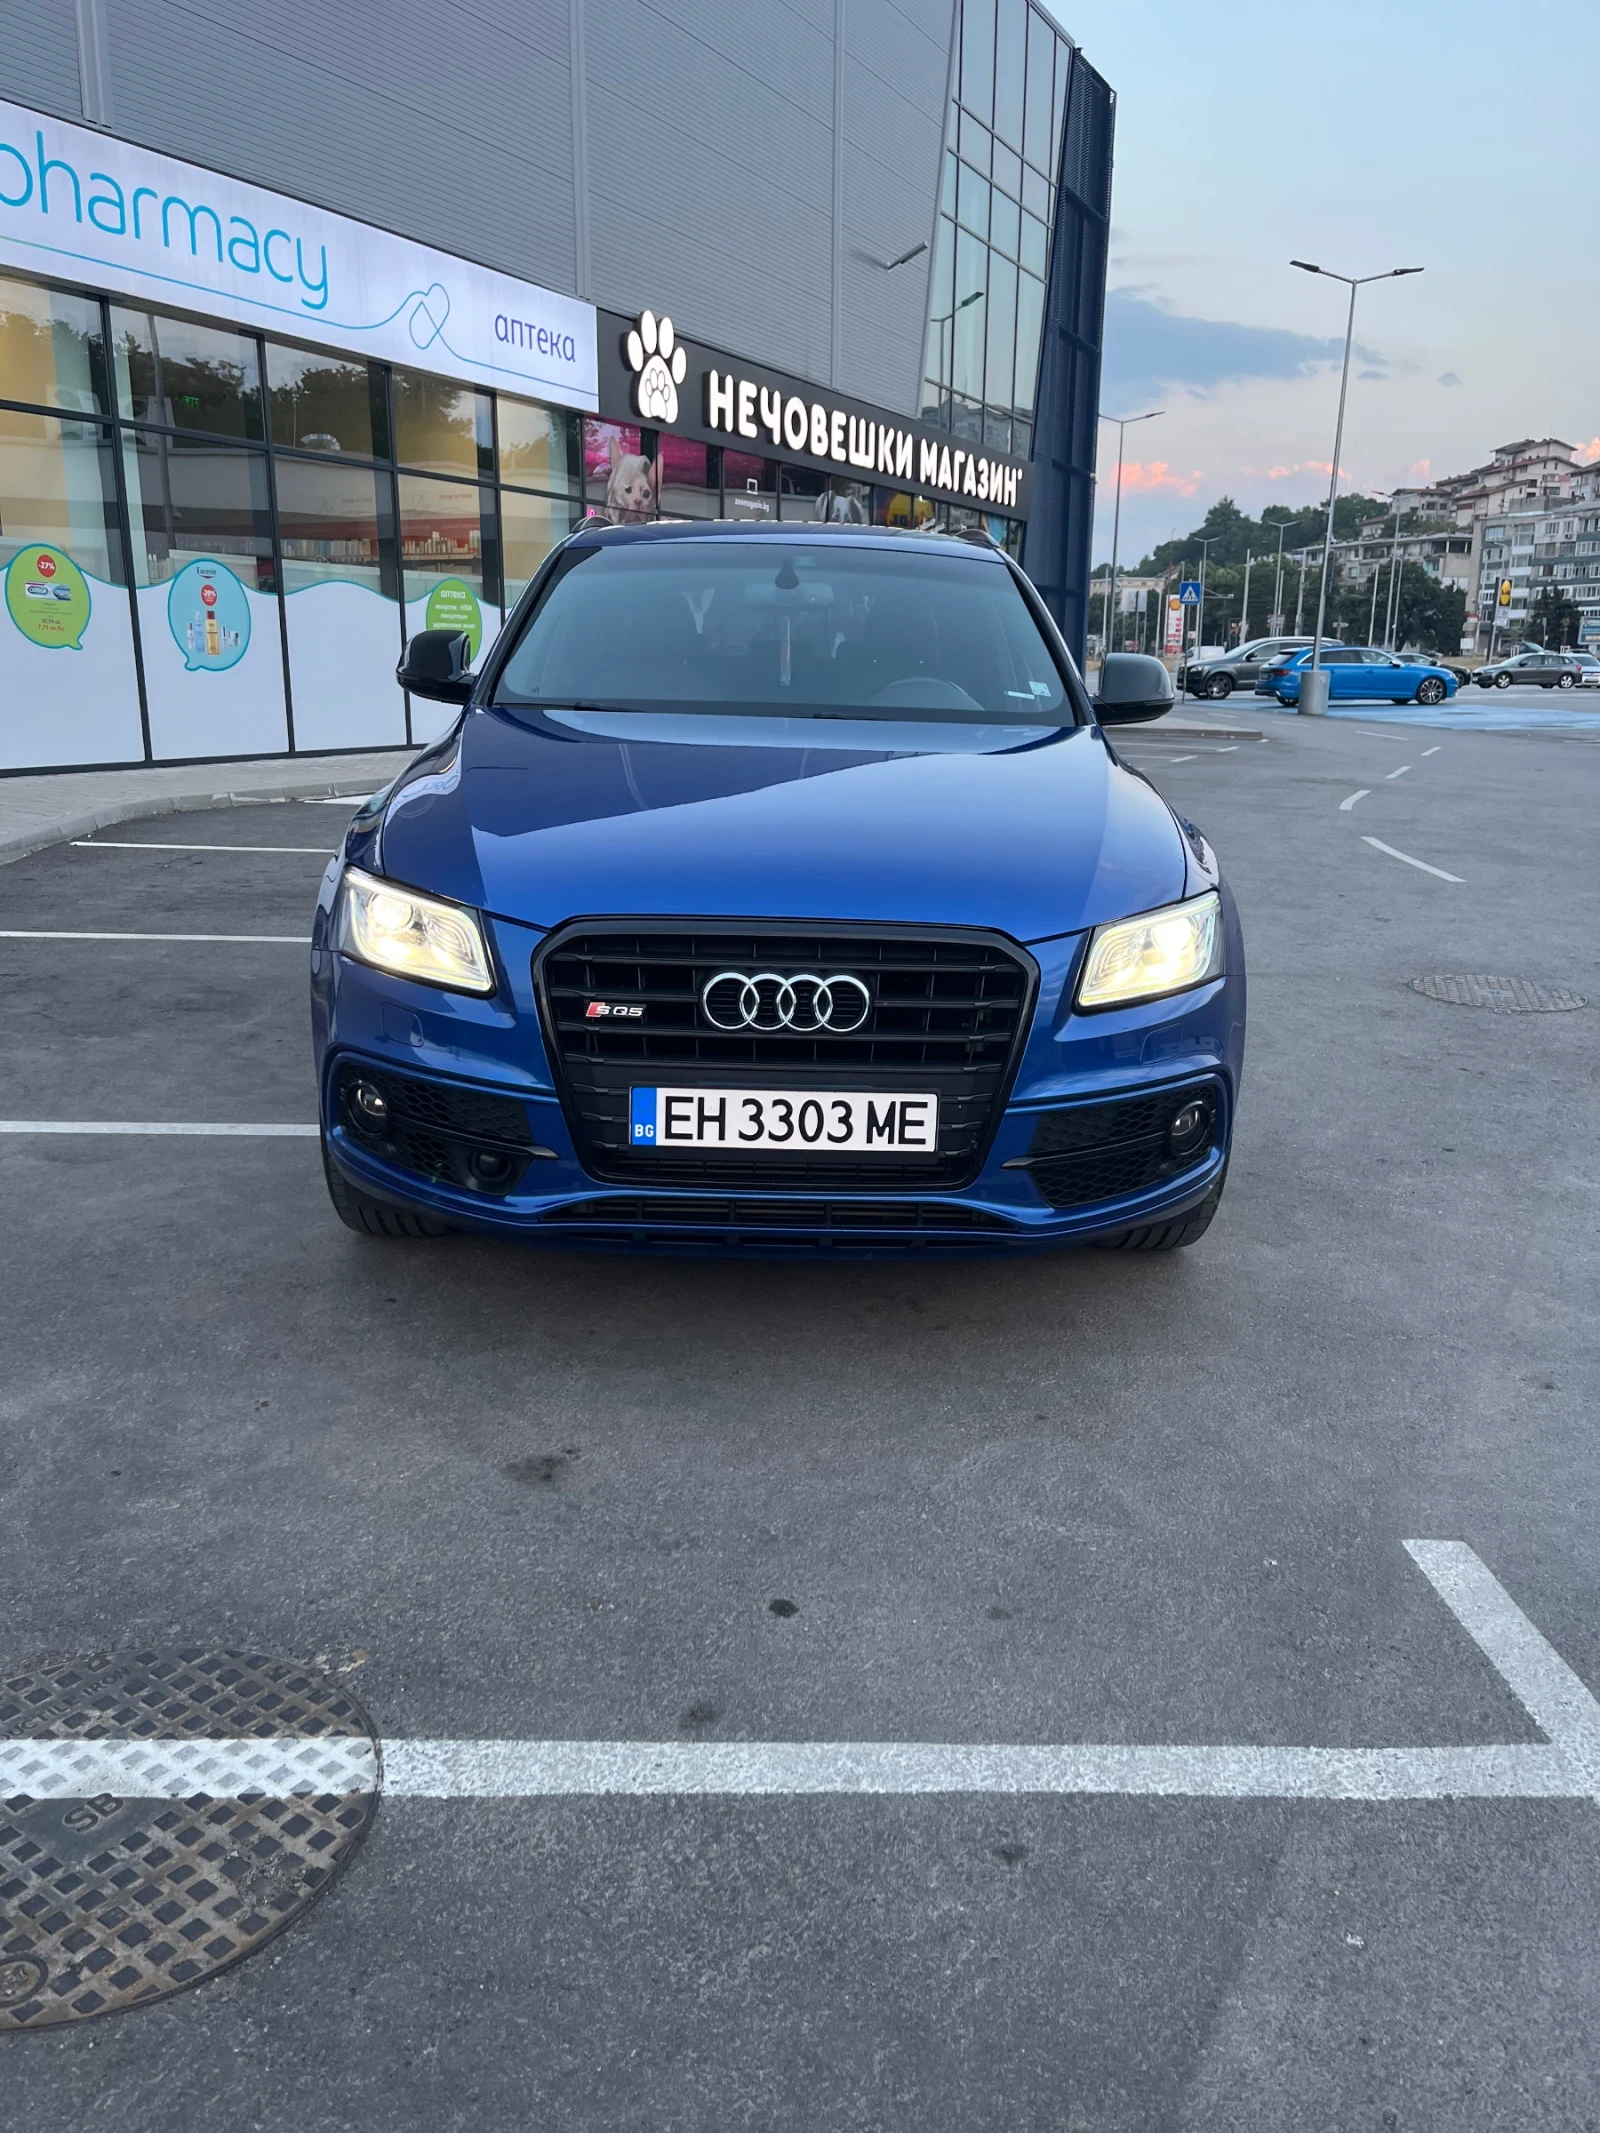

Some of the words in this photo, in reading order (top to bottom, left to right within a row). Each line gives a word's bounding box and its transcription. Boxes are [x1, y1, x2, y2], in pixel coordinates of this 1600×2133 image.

[495, 314, 576, 363] аптека
[709, 369, 913, 480] НЕЧОВЕШКИ
[919, 438, 1017, 507] МАГАЗИН
[38, 562, 55, 570] -27%
[196, 567, 217, 575] Eucerin
[440, 590, 466, 599] аптека
[634, 1123, 654, 1138] BG
[664, 1096, 727, 1141] EH
[738, 1098, 854, 1143] 3303
[866, 1100, 928, 1145] ME
[82, 1666, 131, 1697] IRON
[63, 1792, 124, 1833] SB
